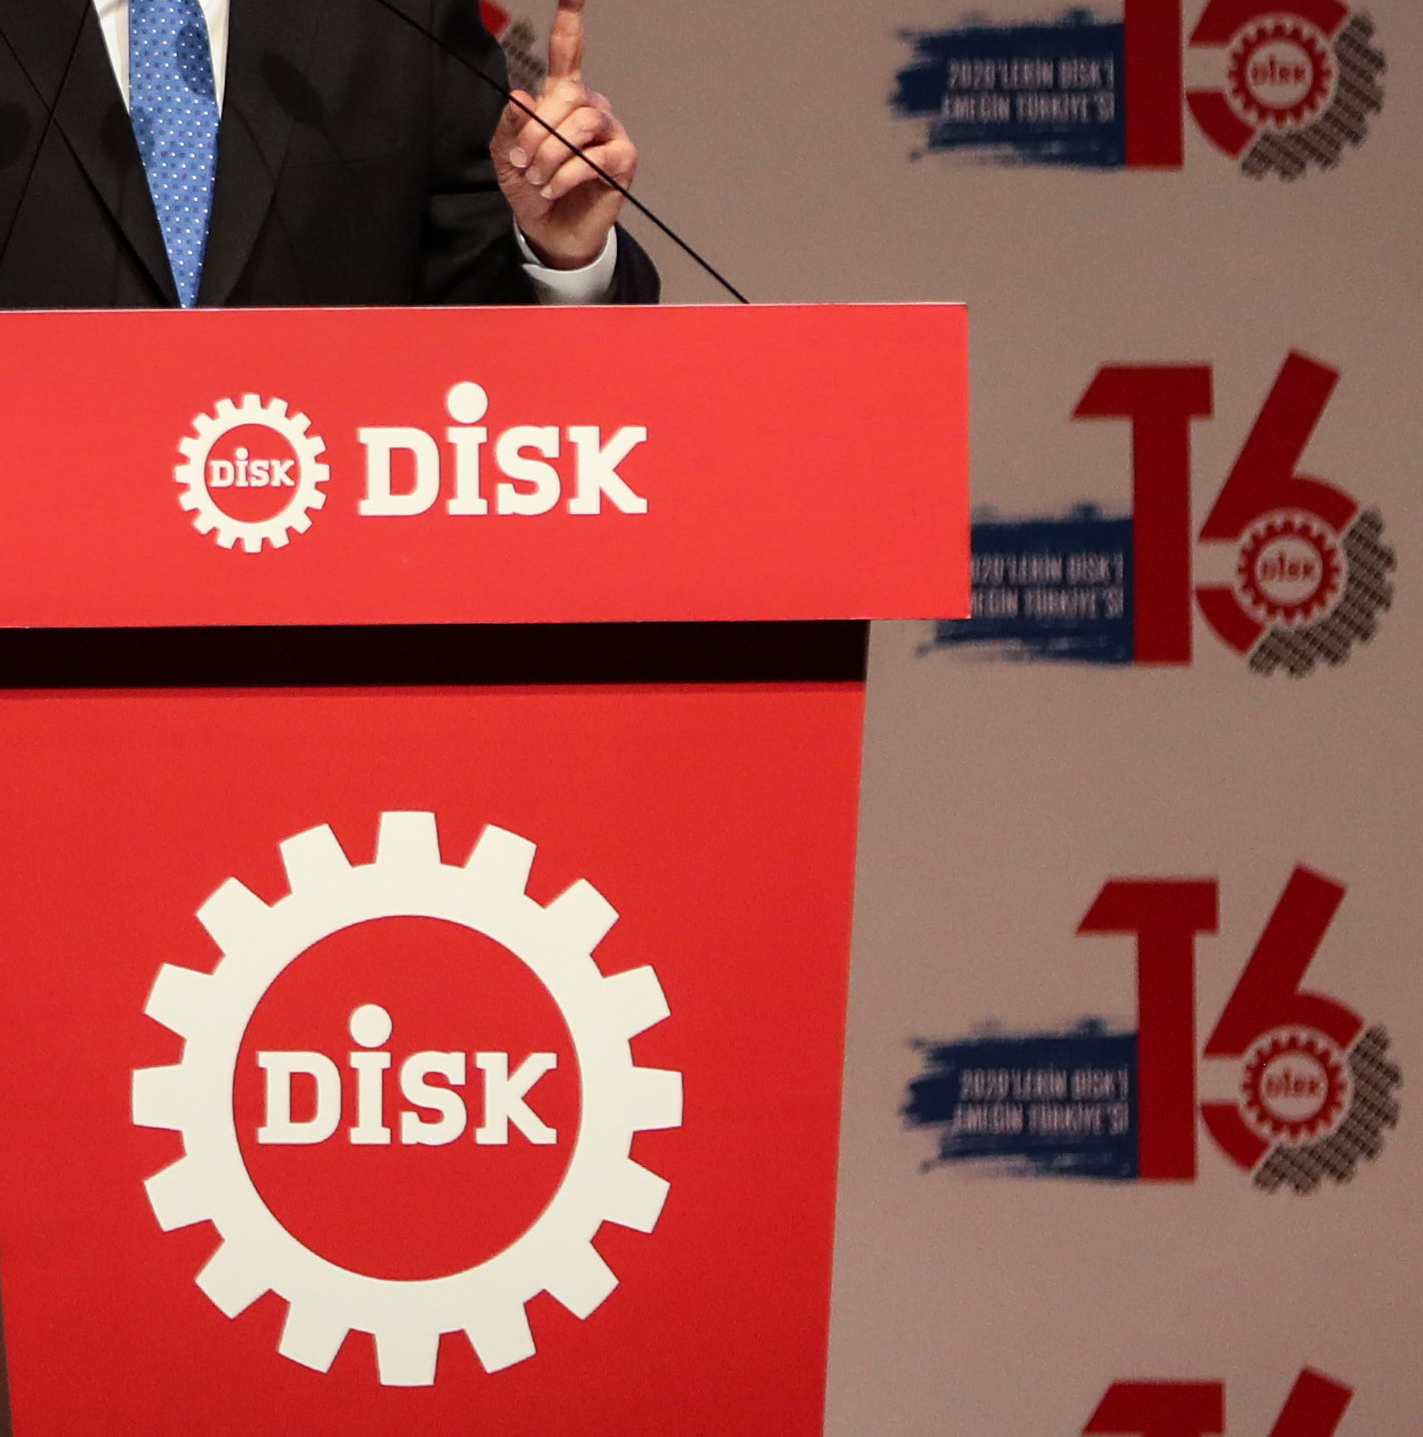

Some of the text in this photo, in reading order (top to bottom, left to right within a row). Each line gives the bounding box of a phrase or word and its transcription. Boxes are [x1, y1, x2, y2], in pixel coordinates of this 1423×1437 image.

[209, 446, 295, 488] DİSK
[357, 380, 648, 516] DİSK
[256, 1003, 557, 1145] DİSK
